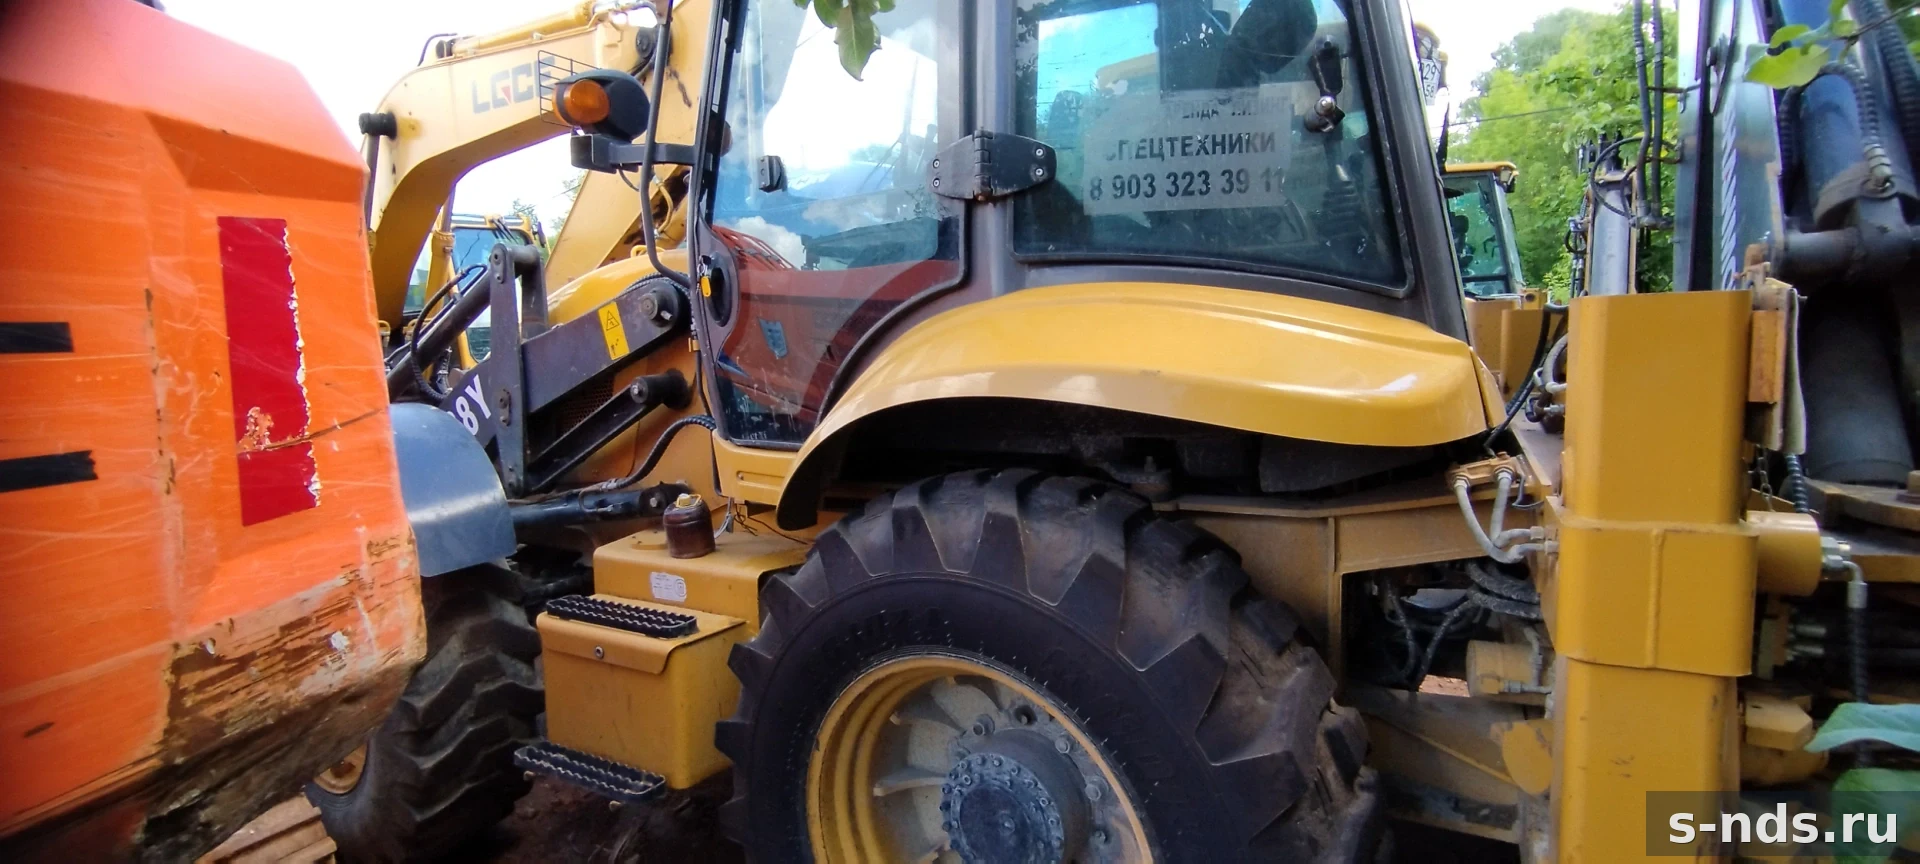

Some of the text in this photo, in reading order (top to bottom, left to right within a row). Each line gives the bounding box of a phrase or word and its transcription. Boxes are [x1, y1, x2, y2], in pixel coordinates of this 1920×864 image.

[472, 55, 555, 114] LGCE
[1090, 177, 1103, 200] 8
[1112, 172, 1156, 199] 903
[1166, 170, 1211, 197] 323
[1221, 168, 1250, 194] 39
[447, 374, 491, 435] 8Y
